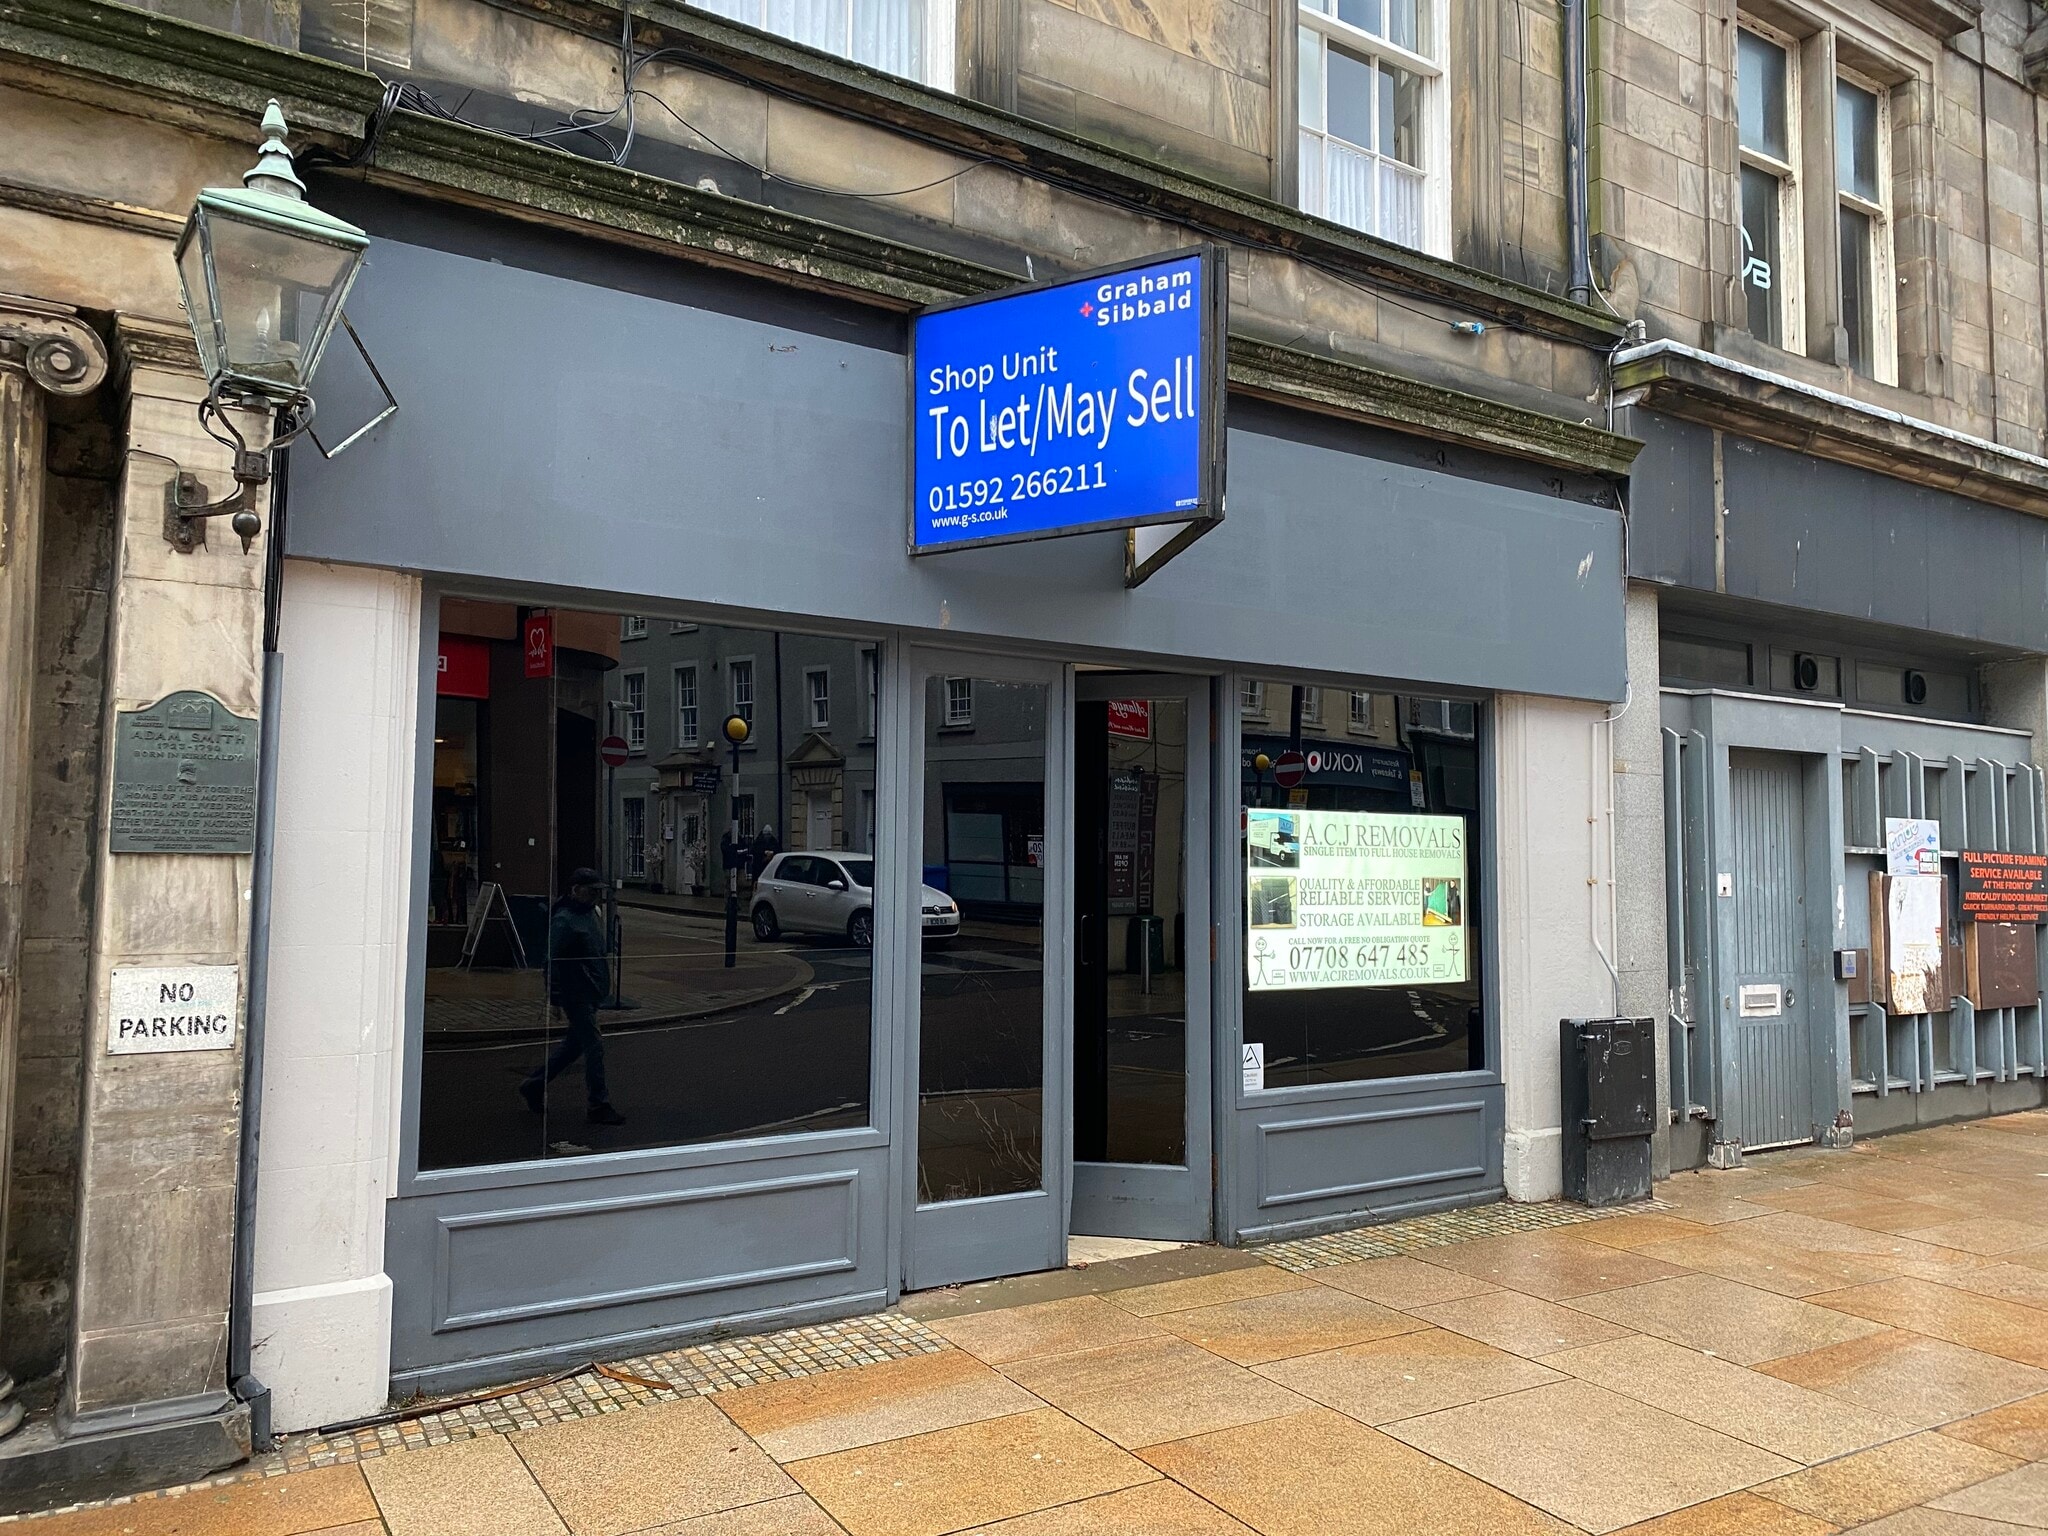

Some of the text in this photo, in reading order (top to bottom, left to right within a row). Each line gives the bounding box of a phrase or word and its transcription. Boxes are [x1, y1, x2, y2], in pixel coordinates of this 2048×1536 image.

[1097, 271, 1191, 302] Graham
[1097, 290, 1191, 326] Sibbald
[930, 346, 1057, 394] Shop Unit
[929, 355, 1194, 460] To Let/May Sell
[929, 462, 1106, 512] 01592 266211
[932, 506, 1008, 527] www.g-s.co.uk
[132, 732, 245, 744] ADAM SMITH
[134, 750, 164, 758] BORN
[234, 786, 253, 794] THE
[1356, 825, 1461, 849] REMOVALS
[1304, 846, 1461, 859] SINGLE ITEM TO FULL HOUSE REMOVALS
[1963, 852, 2047, 866] FULL PICTURE FRAMING
[1970, 868, 2042, 880] SERVICE AVAILABLE
[1300, 879, 1420, 891] QUALITY & AFFORDABLE
[1983, 881, 1991, 889] AT
[1993, 881, 2004, 889] THE
[2025, 882, 2033, 890] OF
[1299, 892, 1420, 906] RELIABLE SERVICE
[1966, 892, 2001, 901] KIRKCALDY
[2002, 893, 2024, 901] INDOOR
[1300, 913, 1420, 927] STORAGE AVAILABLE
[1289, 937, 1306, 945] CALL
[1372, 936, 1409, 944] OBLIGATION
[1410, 936, 1430, 944] QUOTE
[1290, 944, 1429, 970] 07708 647 485
[1289, 967, 1430, 983] WWW.ACJREMOVALS.CO.UK
[160, 983, 194, 1003] NO
[119, 1014, 227, 1038] PARKING
